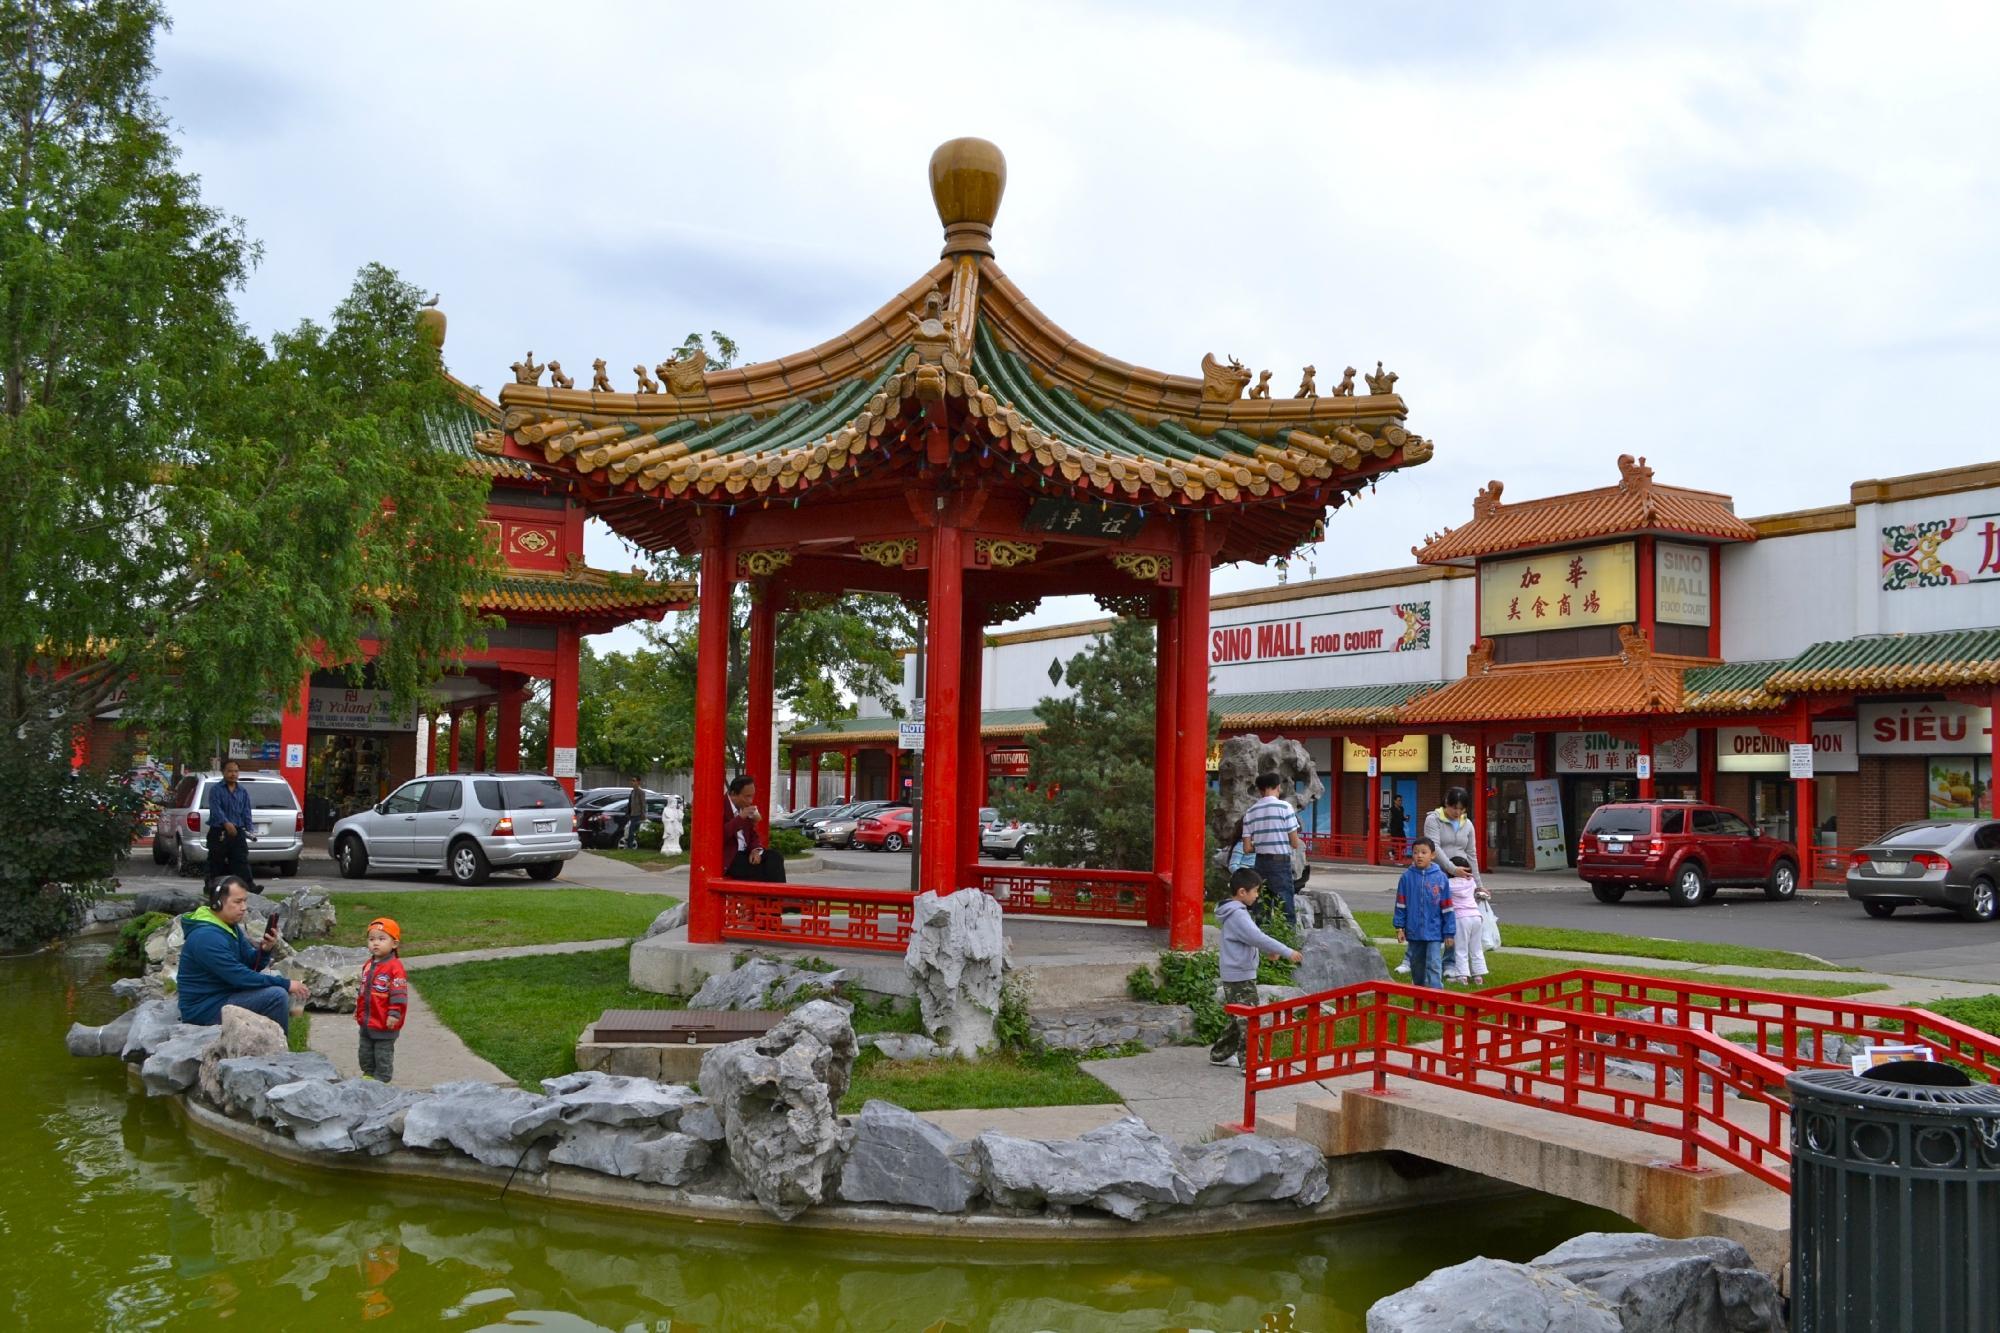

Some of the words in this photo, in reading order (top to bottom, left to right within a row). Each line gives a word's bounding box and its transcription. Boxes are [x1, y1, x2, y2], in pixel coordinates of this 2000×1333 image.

[1664, 551, 1702, 573] SINO
[1660, 575, 1707, 597] MALL
[1506, 589, 1600, 621] 美食商場
[1660, 600, 1681, 613] FOOD
[1682, 602, 1707, 616] COURT
[1212, 627, 1252, 663] SINO
[1257, 621, 1306, 659] MALL
[1310, 633, 1341, 654] FOOD
[1344, 629, 1384, 651] COURT
[329, 701, 372, 714] Yoland
[902, 724, 924, 733] NOTI
[1584, 733, 1619, 750] SINO
[1734, 734, 1790, 753] OPENIN
[1812, 734, 1842, 752] OON
[1382, 748, 1397, 758] GIFT
[1398, 748, 1418, 758] SHOP
